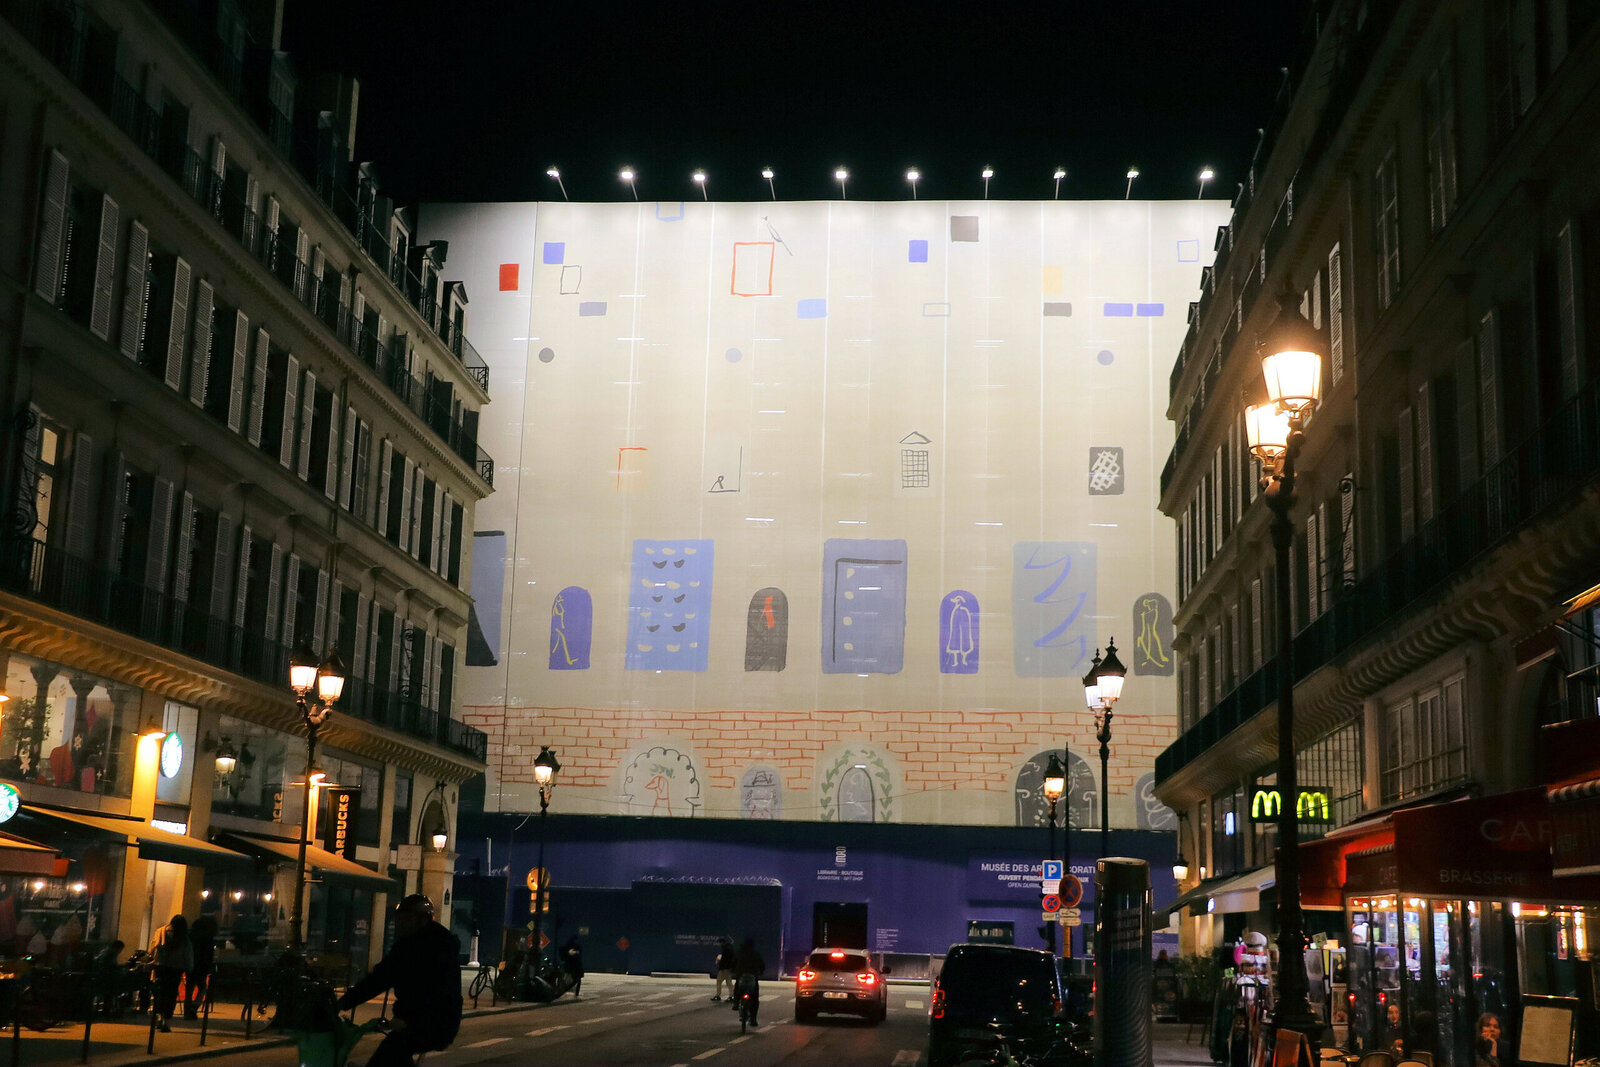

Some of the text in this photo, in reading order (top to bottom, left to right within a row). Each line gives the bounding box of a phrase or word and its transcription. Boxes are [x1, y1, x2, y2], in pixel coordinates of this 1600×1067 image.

[334, 793, 350, 858] ARBUCKS
[981, 862, 1011, 872] MUSÉE
[1012, 864, 1029, 872] DES
[1047, 864, 1058, 877] P
[1439, 868, 1530, 888] BRASSERIE
